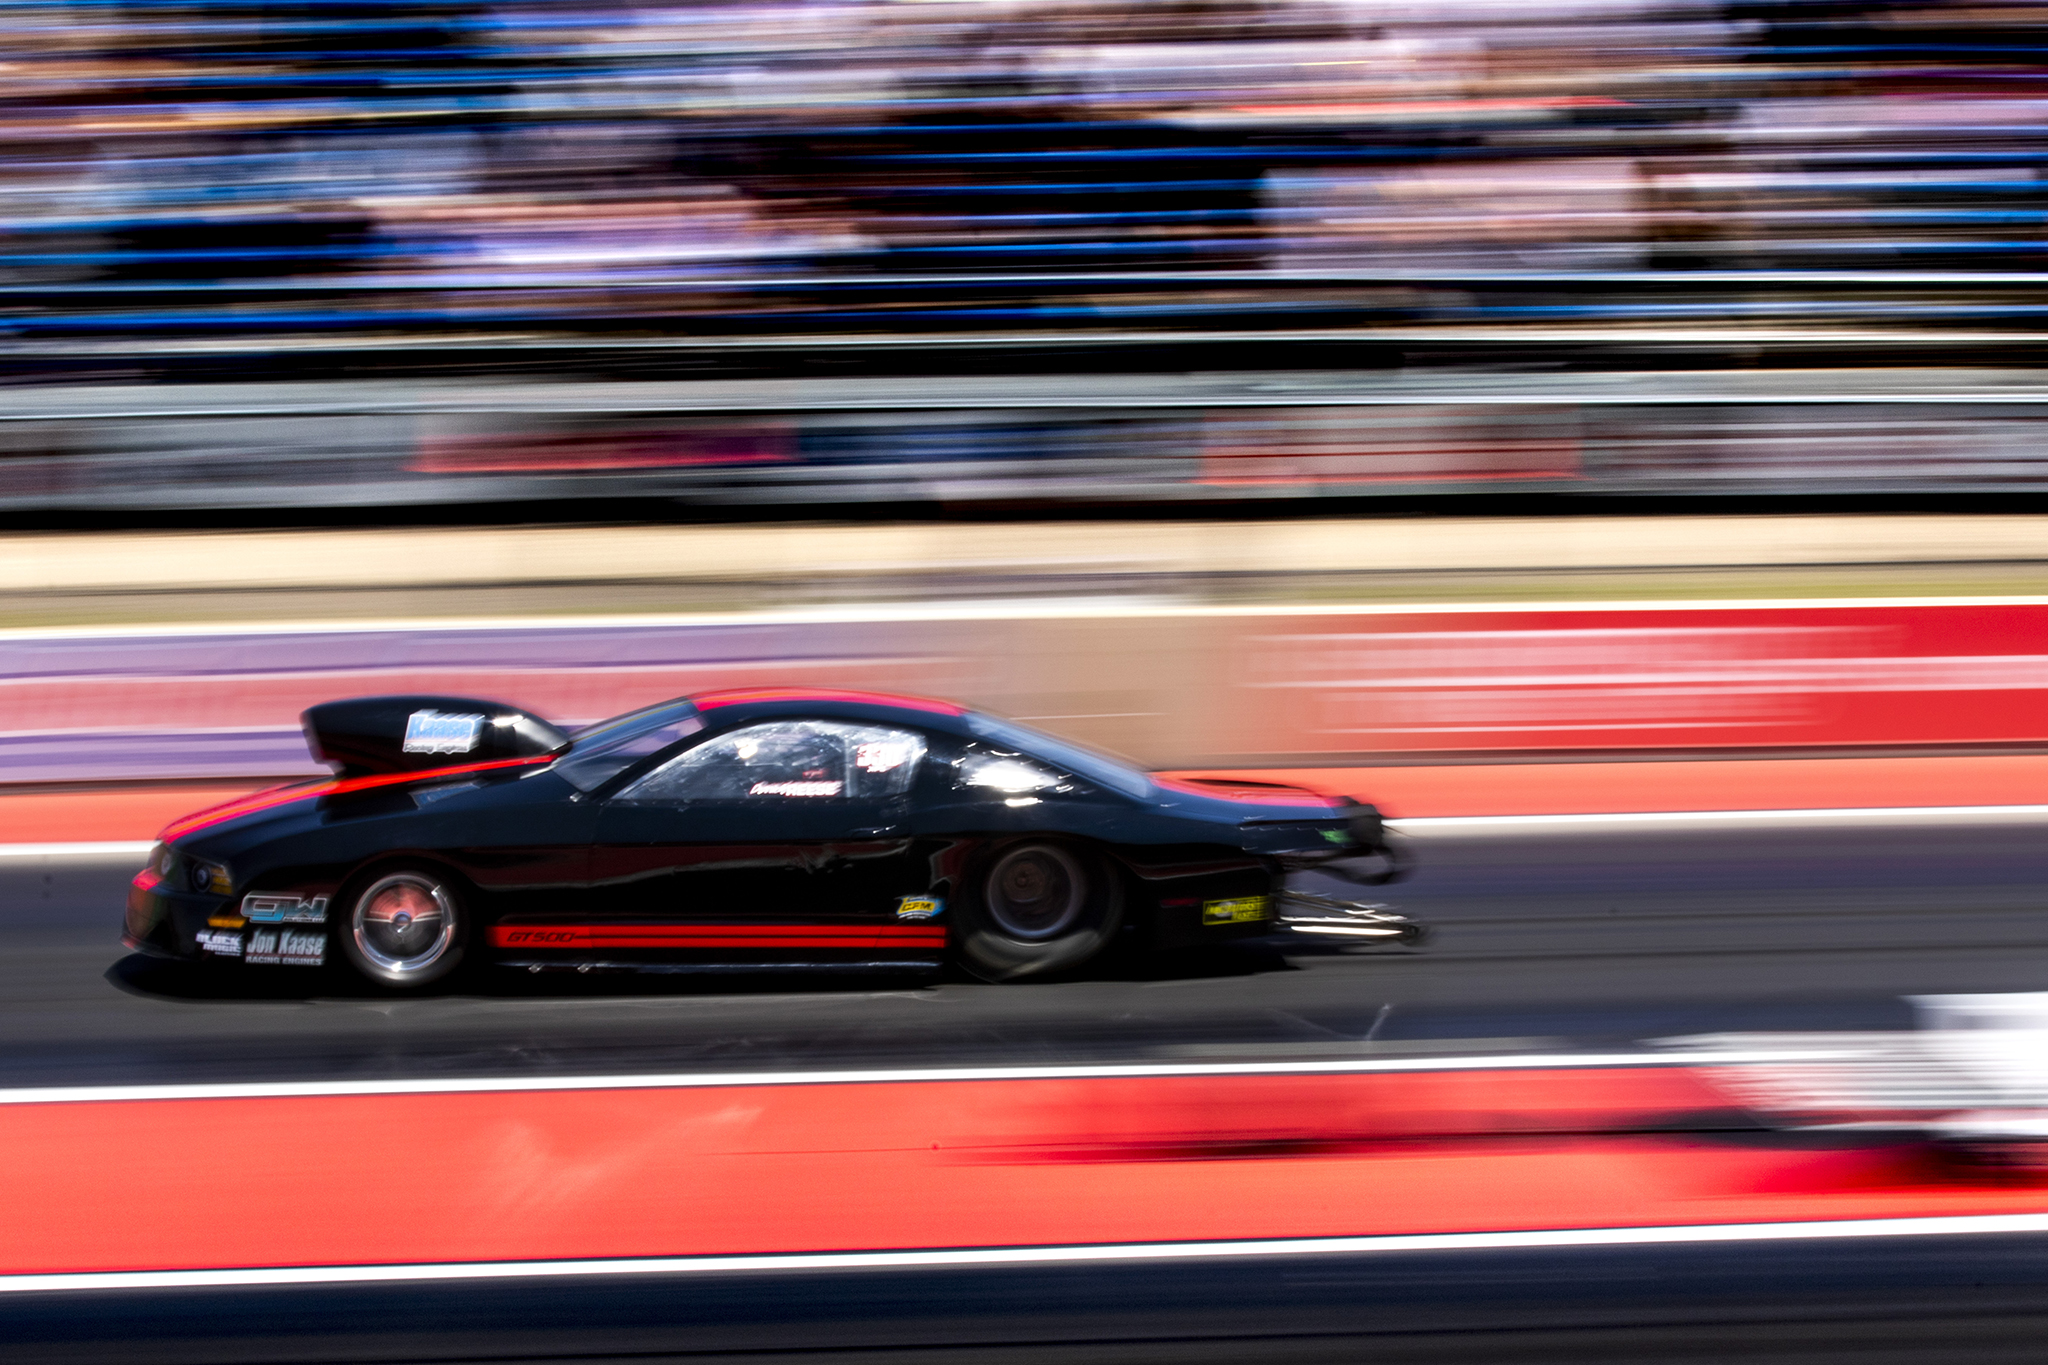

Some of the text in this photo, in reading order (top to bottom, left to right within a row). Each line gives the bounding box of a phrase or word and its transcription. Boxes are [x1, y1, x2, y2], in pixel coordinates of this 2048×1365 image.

[786, 782, 841, 796] REESE
[246, 929, 326, 955] Jon Kaase
[507, 932, 576, 942] GT500
[245, 956, 325, 967] RACING ENGINES
